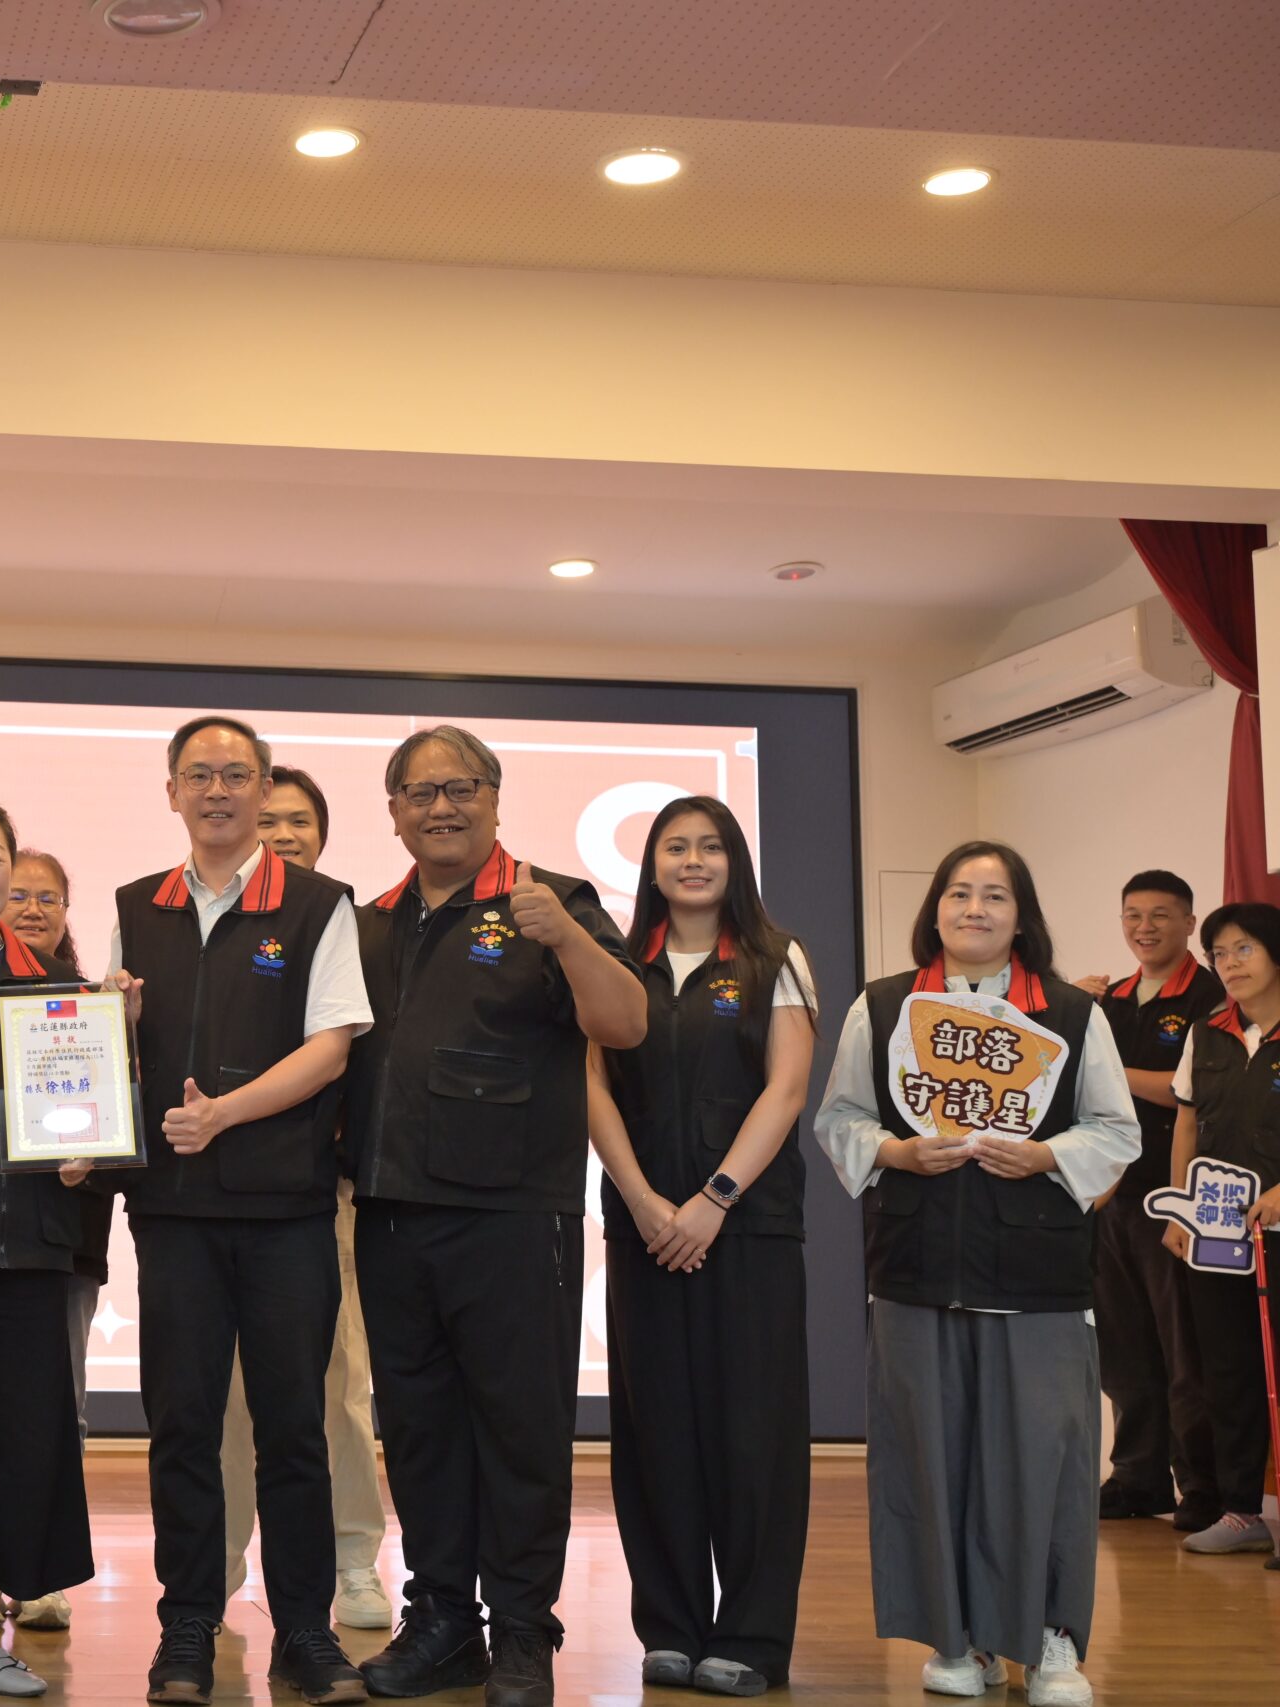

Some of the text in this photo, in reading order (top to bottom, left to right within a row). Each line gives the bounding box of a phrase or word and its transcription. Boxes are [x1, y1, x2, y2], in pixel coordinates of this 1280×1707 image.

[40, 1022, 88, 1032] 花蓮縣政府
[933, 1021, 1020, 1072] 部落
[905, 1074, 1031, 1133] 守護星
